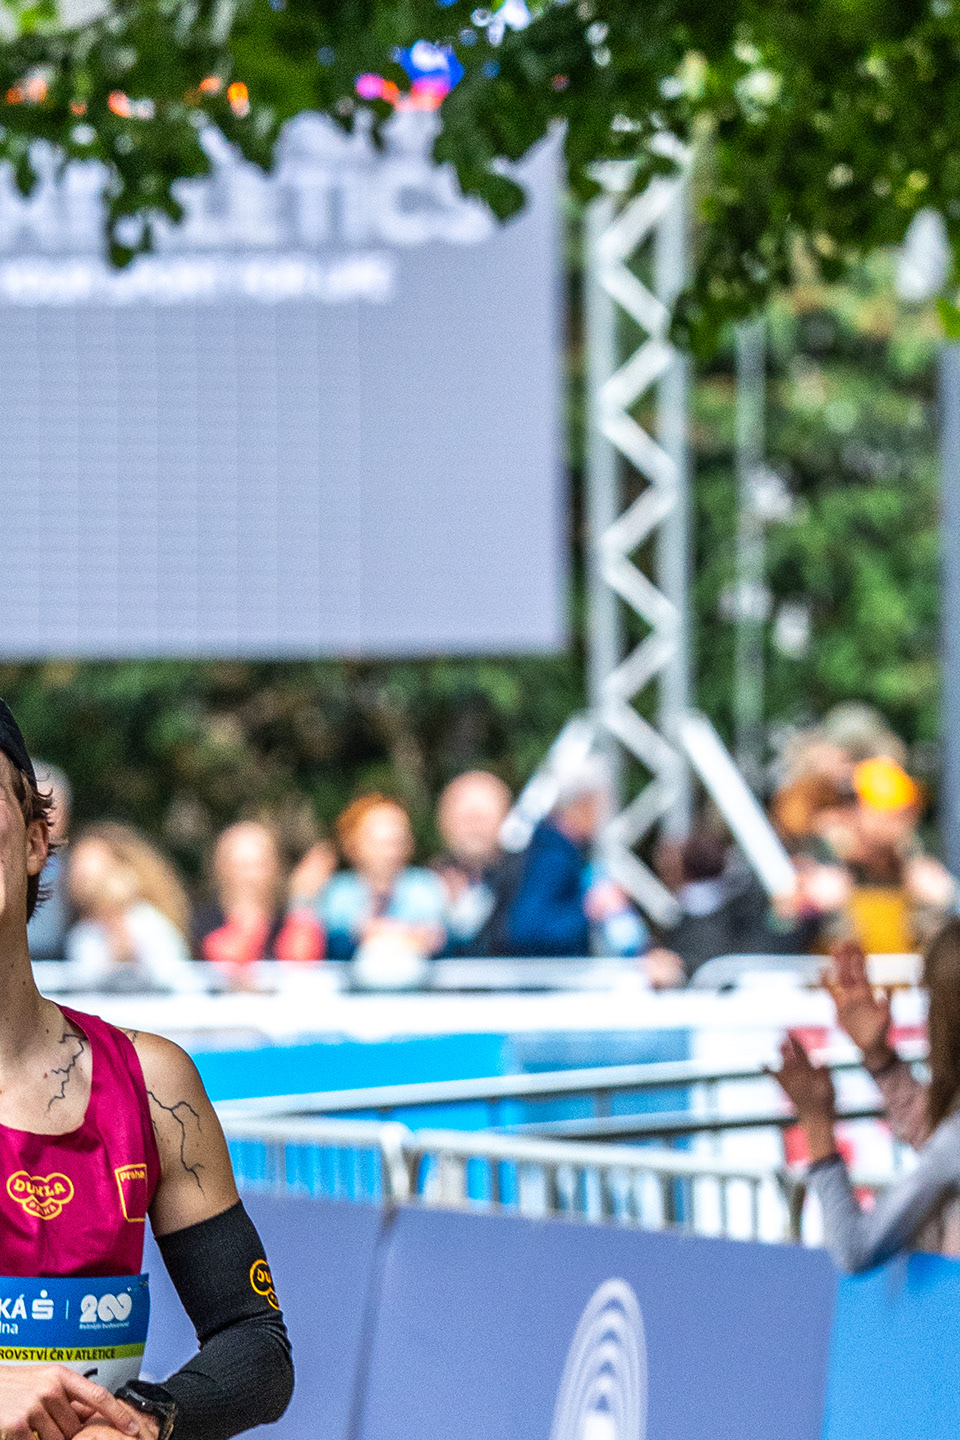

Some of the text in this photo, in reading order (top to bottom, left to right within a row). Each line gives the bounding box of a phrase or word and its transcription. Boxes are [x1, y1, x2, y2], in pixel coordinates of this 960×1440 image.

[14, 1179, 66, 1197] DUKLA
[50, 1347, 64, 1361] ČR
[65, 1349, 73, 1361] V
[74, 1348, 116, 1361] ATLETICE
